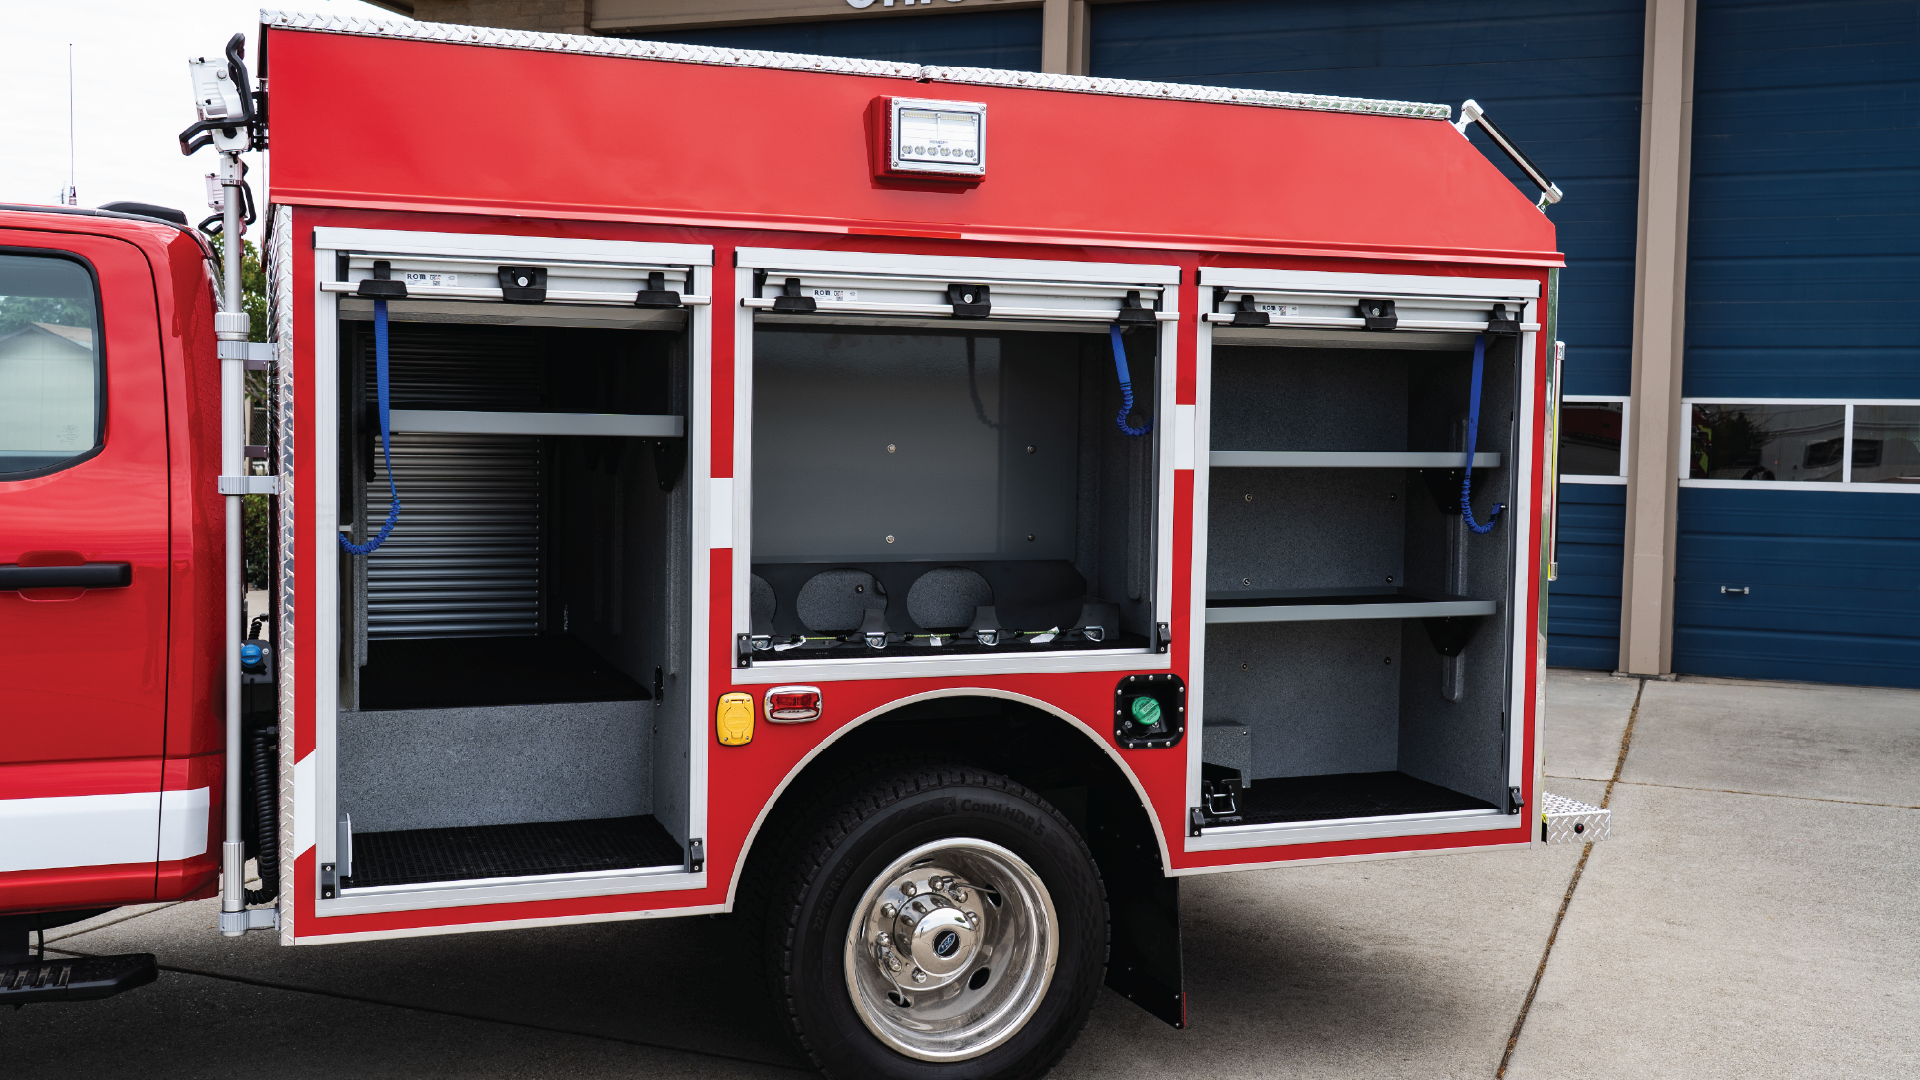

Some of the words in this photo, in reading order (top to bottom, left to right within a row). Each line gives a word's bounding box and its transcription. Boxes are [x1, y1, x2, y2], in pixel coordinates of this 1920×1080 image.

[960, 799, 1003, 816] Conti
[1003, 806, 1036, 831] HDR
[1033, 822, 1046, 837] 5
[812, 890, 835, 932] 225/70
[829, 880, 841, 891] R
[835, 858, 854, 881] 19.5
